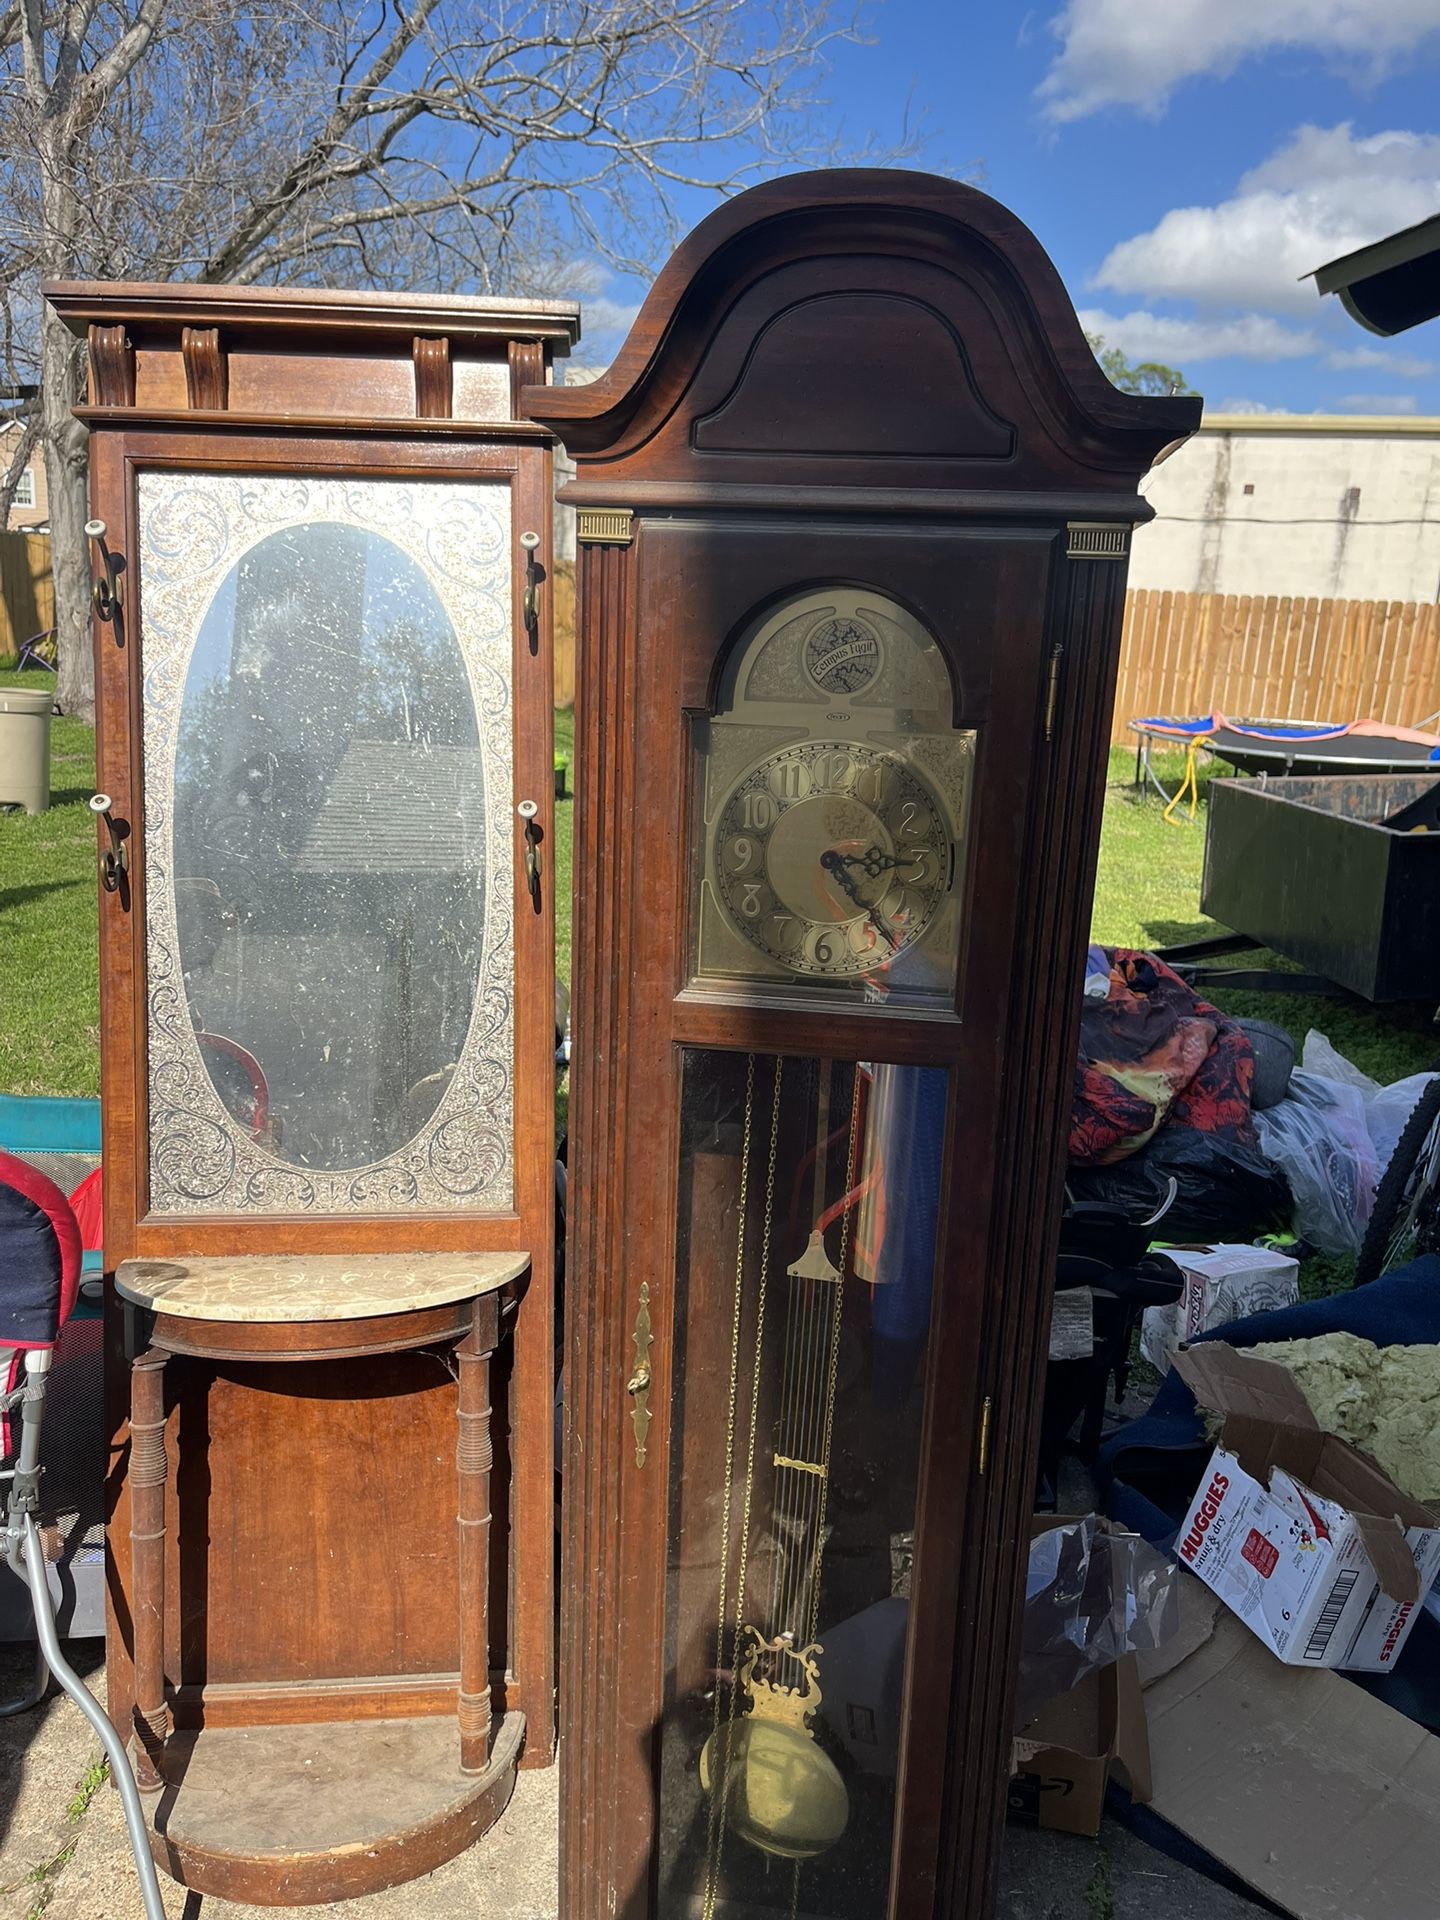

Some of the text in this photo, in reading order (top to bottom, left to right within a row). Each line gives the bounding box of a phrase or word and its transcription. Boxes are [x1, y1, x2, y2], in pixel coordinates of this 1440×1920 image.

[813, 648, 849, 676] Tempus
[779, 763, 801, 799] 11
[821, 752, 851, 791] 12
[874, 766, 886, 802] 1
[743, 793, 771, 829] 10
[900, 801, 918, 834] 2
[734, 837, 752, 872] 9
[911, 848, 930, 883] 3
[741, 883, 762, 918] 8
[773, 915, 793, 950] 7
[814, 931, 833, 964] 6
[856, 921, 877, 955] 5
[1180, 1471, 1229, 1562] HUGGIES
[1194, 1514, 1226, 1570] snug & dry
